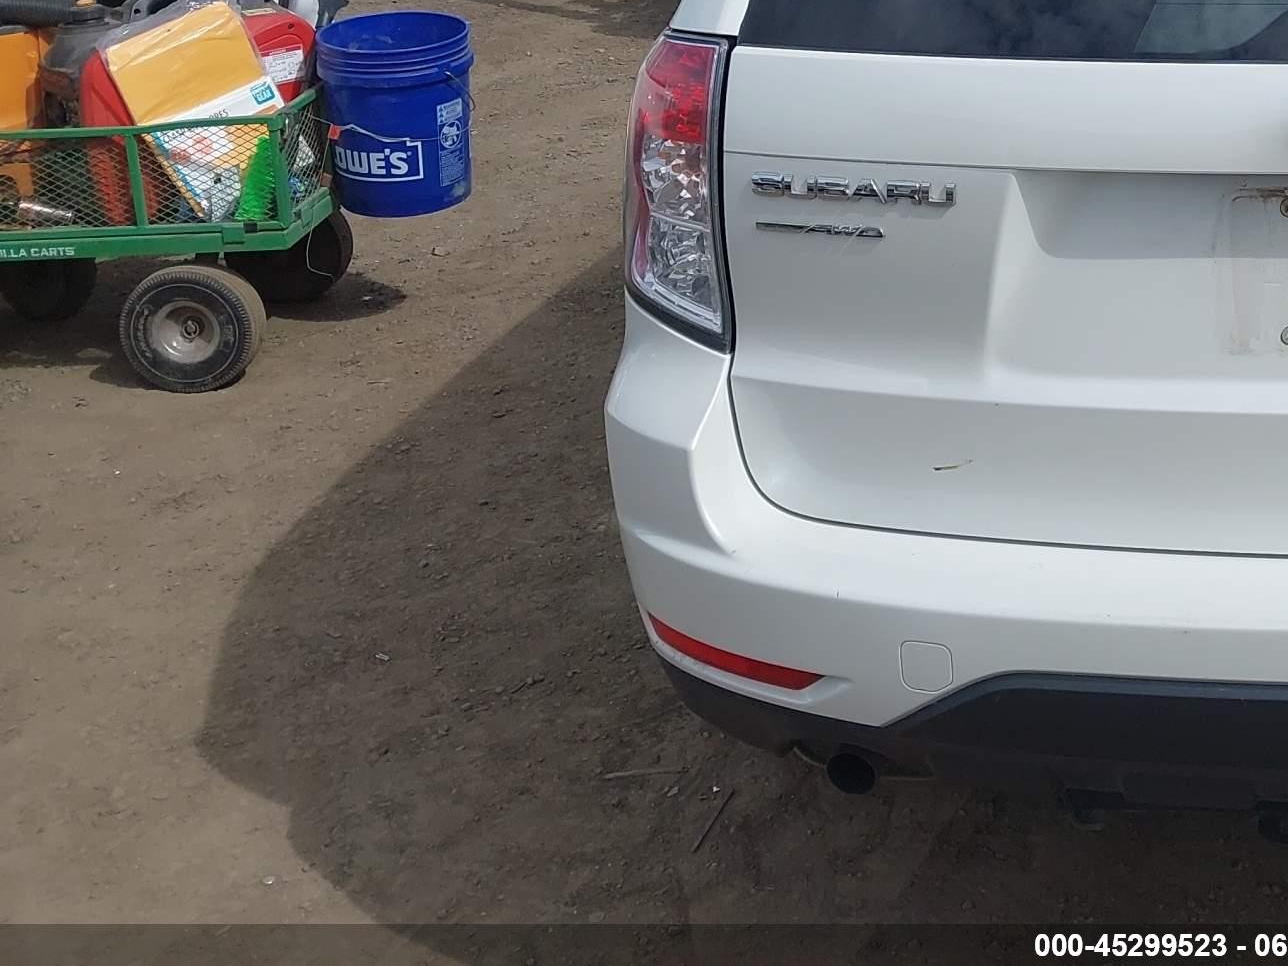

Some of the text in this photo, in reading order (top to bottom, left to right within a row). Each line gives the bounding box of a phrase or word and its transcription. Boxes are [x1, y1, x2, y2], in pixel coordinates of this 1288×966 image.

[334, 146, 409, 175] OWE'S
[751, 170, 957, 205] SUBARU
[30, 246, 76, 257] CARTS
